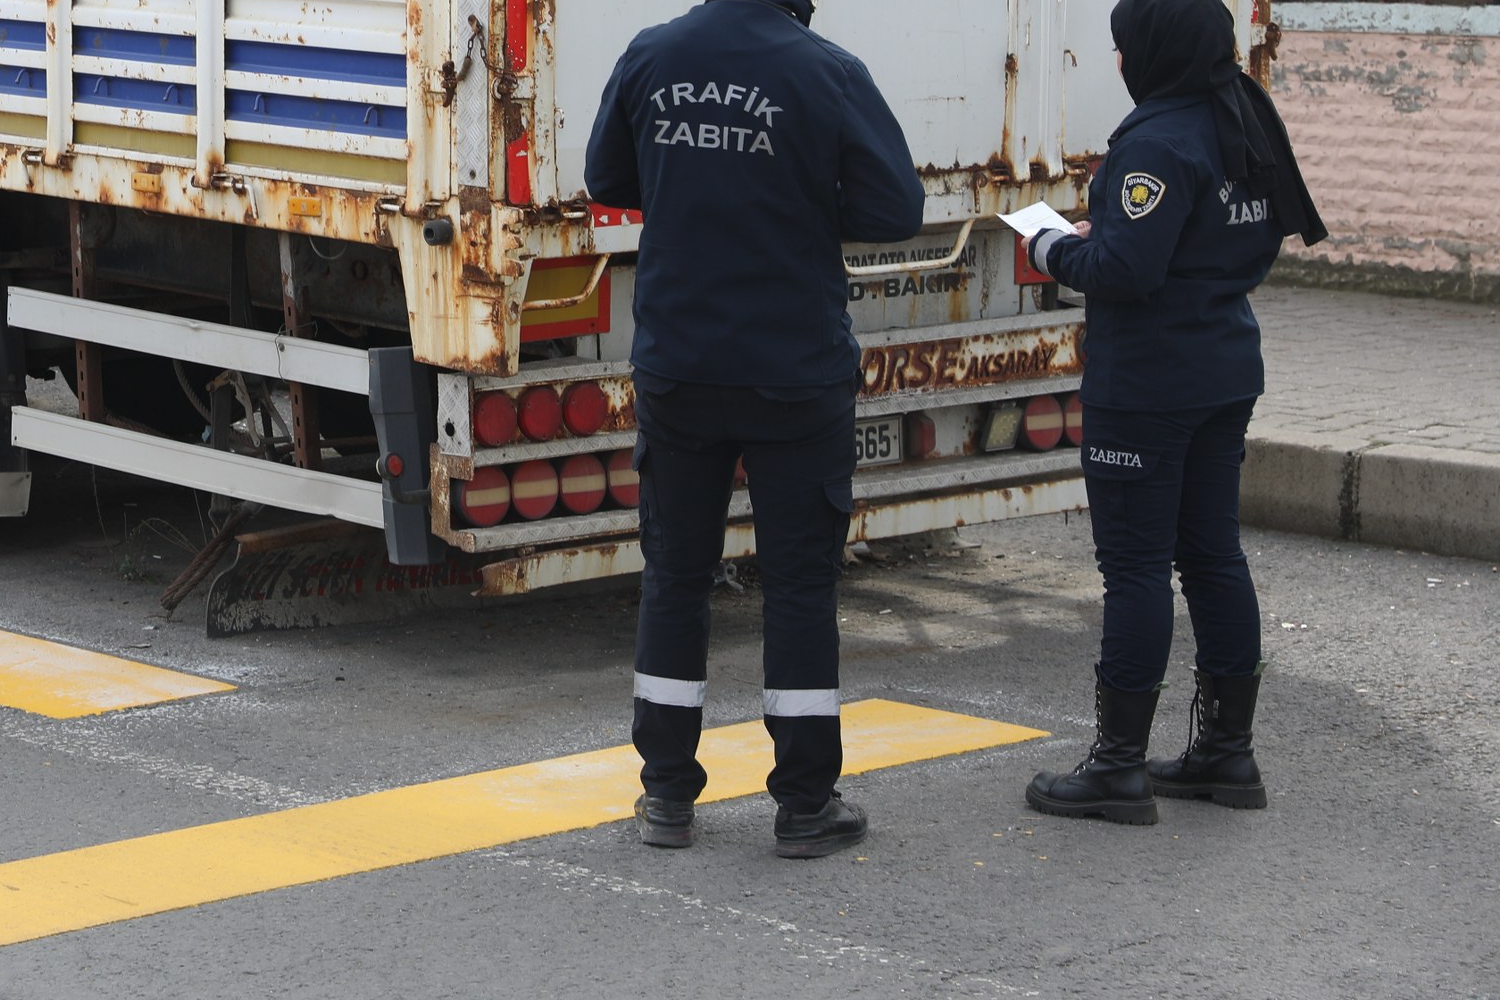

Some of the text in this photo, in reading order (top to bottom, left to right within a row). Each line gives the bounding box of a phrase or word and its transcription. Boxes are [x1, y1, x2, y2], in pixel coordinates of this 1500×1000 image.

[650, 81, 784, 128] TRAFİK
[654, 120, 775, 156] ZABITA
[1226, 198, 1273, 225] ZABI
[965, 345, 1058, 382] AKSARAY
[1089, 446, 1143, 468] ZABITA
